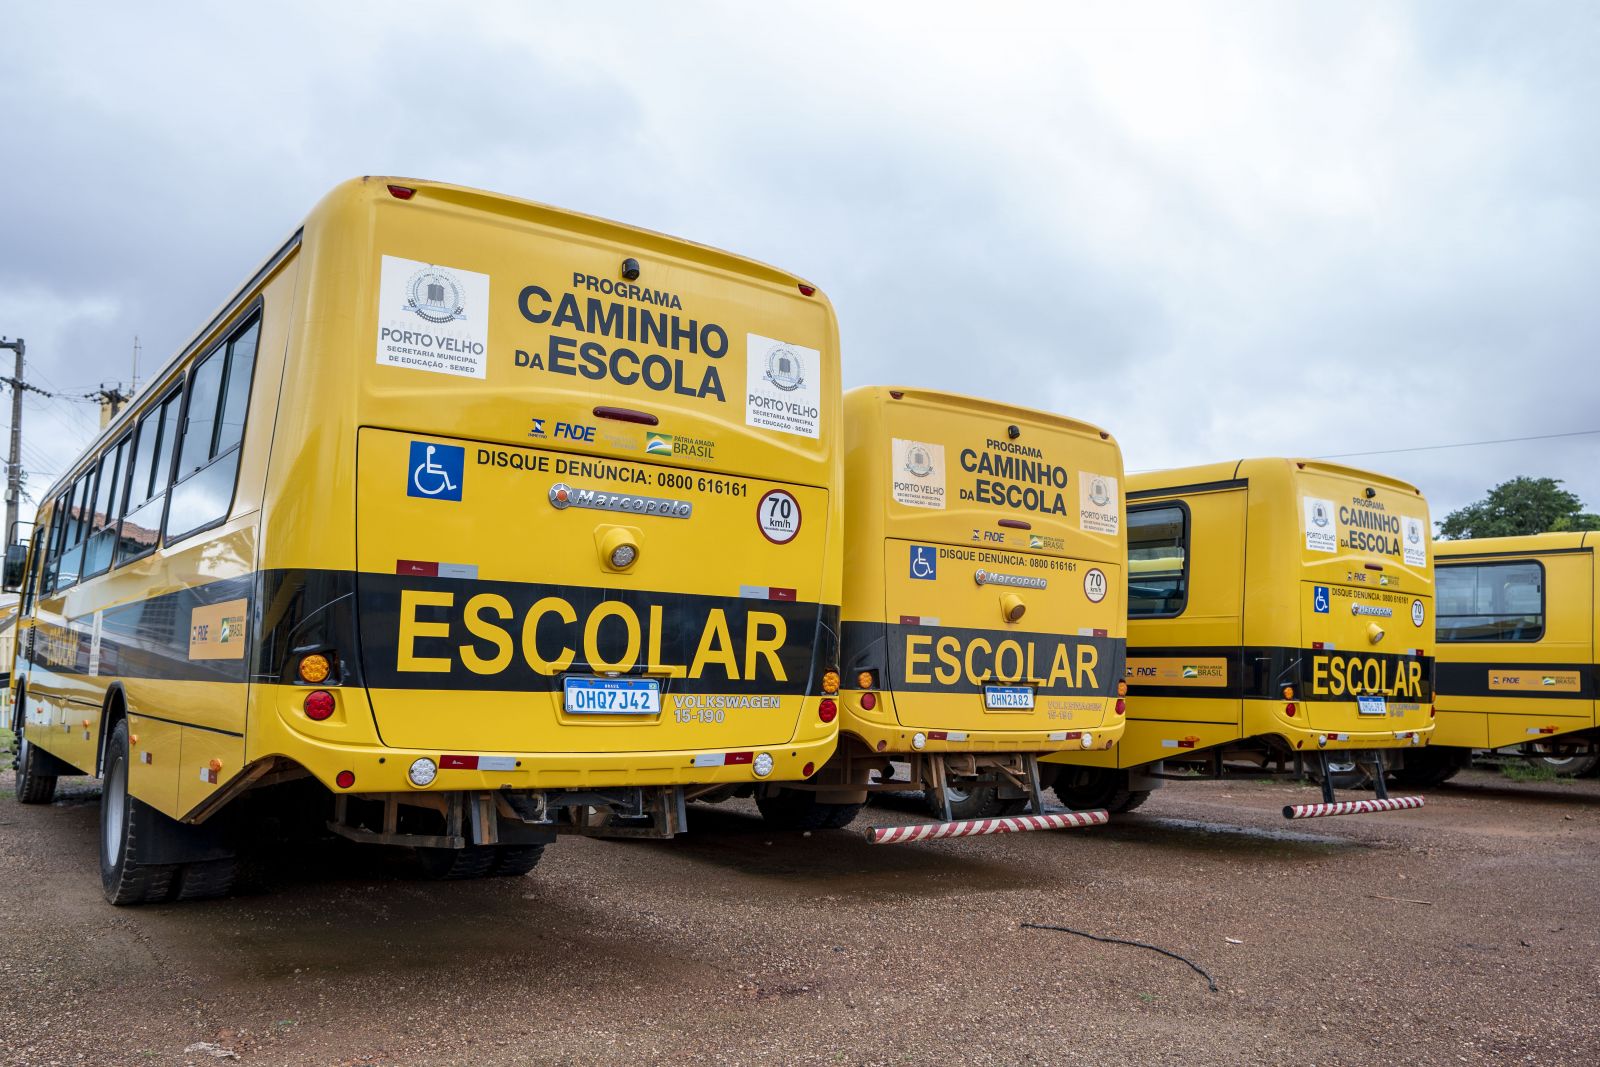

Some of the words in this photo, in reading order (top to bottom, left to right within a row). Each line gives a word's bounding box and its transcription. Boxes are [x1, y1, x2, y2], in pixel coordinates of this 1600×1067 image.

[573, 272, 682, 310] PROGRAMA
[518, 285, 729, 359] CAMINHO
[381, 327, 433, 347] PORTO
[435, 335, 484, 355] VELHO
[386, 345, 435, 358] SECRETARIA
[436, 352, 478, 364] MUNICIPAL
[401, 356, 444, 368] EDUCAÇÃO
[449, 364, 475, 373] SEMED
[515, 350, 544, 371] DA
[548, 334, 726, 402] ESCOLA
[749, 394, 784, 412] PORTO
[785, 402, 818, 419] VELHO
[752, 409, 786, 420] SECRETARIA
[786, 416, 814, 427] MUNICIPAL
[554, 422, 597, 442] FNDE
[673, 435, 694, 445] PÁTRIA
[694, 439, 715, 448] AMADA
[673, 442, 714, 459] BRASIL
[986, 438, 1043, 459] PROGRAMA
[477, 448, 550, 475] DISQUE
[555, 456, 653, 486] DENÚNCIA:
[657, 472, 693, 491] 0800
[697, 477, 748, 497] 616161
[960, 448, 1068, 489] CAMINHO
[894, 482, 920, 493] PORTO
[920, 484, 944, 496] VELHO
[960, 488, 974, 501] DA
[976, 478, 1067, 516] ESCOLA
[577, 489, 690, 517] Marcopolo
[769, 497, 791, 519] 70
[1353, 497, 1385, 510] PROGRAMA
[769, 518, 791, 529] km/h
[1080, 510, 1099, 520] PORTO
[1339, 506, 1399, 534] CAMINHO
[983, 531, 1004, 543] FNDE
[1043, 540, 1065, 550] BRASIL
[1341, 539, 1350, 548] DA
[1349, 530, 1400, 556] ESCOLA
[940, 548, 976, 561] DISQUE
[978, 551, 1028, 567] DENÚNCIA:
[1029, 558, 1048, 569] 0800
[1050, 560, 1077, 572] 616161
[988, 572, 1046, 587] Marcopolo
[1089, 574, 1102, 587] 70
[1331, 588, 1353, 598] DISQUE
[397, 589, 788, 681] ESCOLAR
[904, 634, 1099, 689] ESCOLAR
[1136, 667, 1157, 676] FNDE
[1198, 669, 1222, 677] BRASIL
[1312, 655, 1422, 697] ESCOLAR
[576, 690, 650, 709] OHQ7J42
[673, 695, 780, 709] VOLKSWAGEN
[991, 694, 1029, 706] OHN2A82
[674, 709, 725, 723] 15-190
